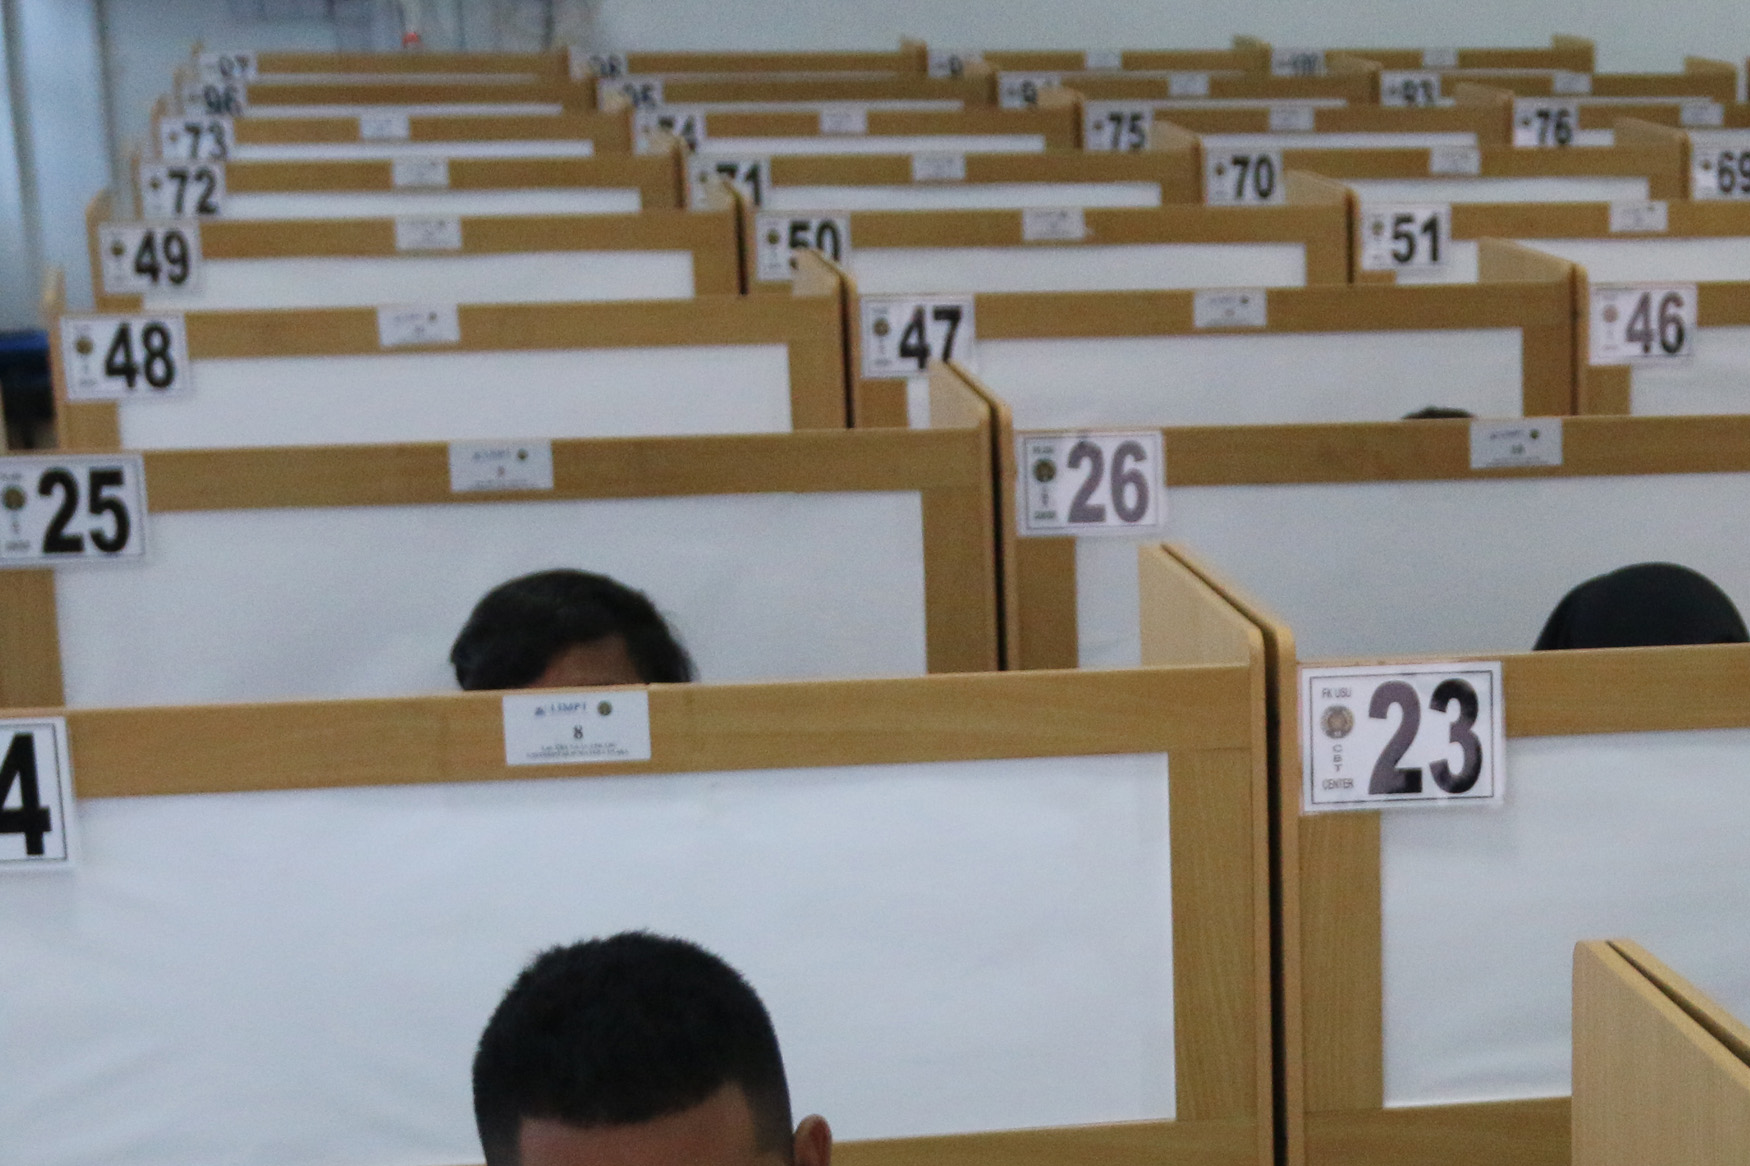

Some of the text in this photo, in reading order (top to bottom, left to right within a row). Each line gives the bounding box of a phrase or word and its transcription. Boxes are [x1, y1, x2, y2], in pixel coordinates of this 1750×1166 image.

[184, 120, 229, 162] 73
[1108, 111, 1146, 152] 75
[1536, 109, 1573, 146] 76
[167, 166, 220, 214] 72
[1231, 153, 1276, 200] 70
[134, 228, 191, 286] 49
[1391, 213, 1440, 264] 51
[898, 304, 964, 370] 47
[1625, 290, 1686, 354] 46
[104, 321, 177, 389] 48
[1067, 440, 1149, 523] 26
[38, 466, 131, 553] 25
[573, 725, 584, 740] 8
[1368, 677, 1483, 795] 23
[1322, 778, 1355, 790] CENTER
